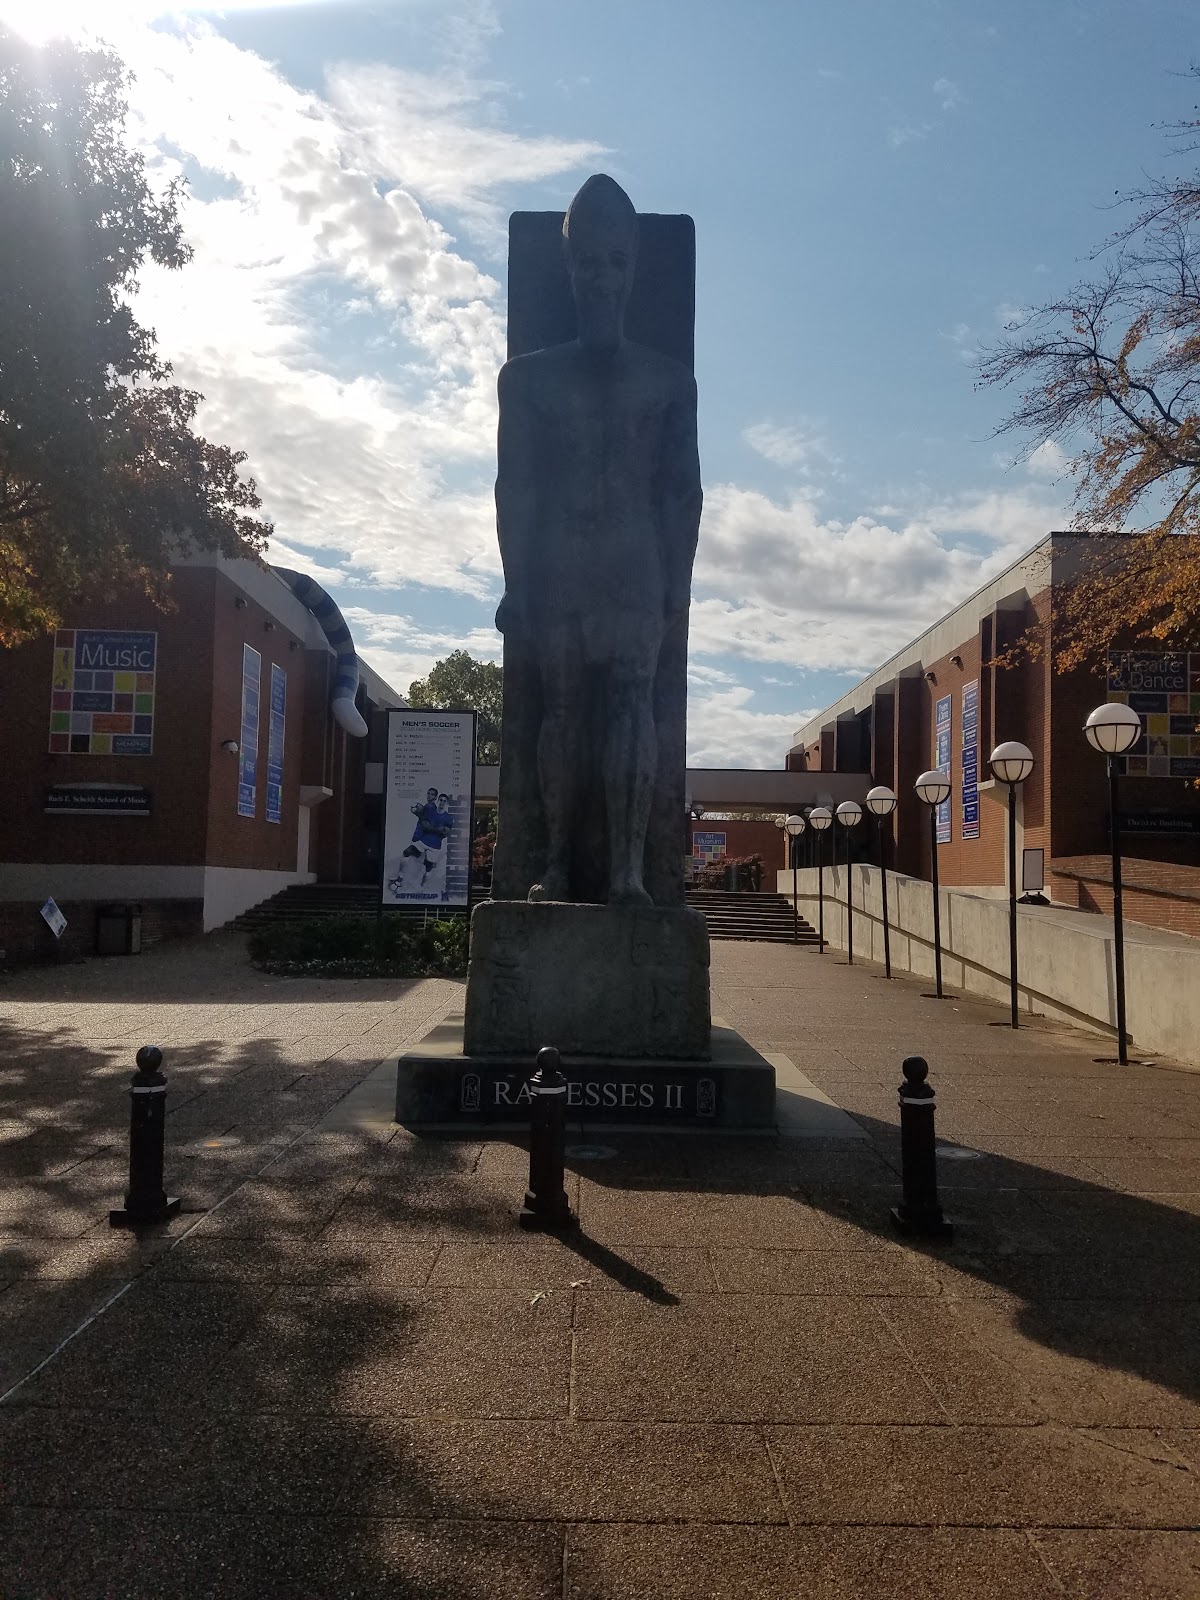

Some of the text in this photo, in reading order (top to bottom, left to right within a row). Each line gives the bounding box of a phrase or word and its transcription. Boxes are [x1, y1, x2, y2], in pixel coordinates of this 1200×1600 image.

[81, 643, 151, 667] Music
[1113, 671, 1184, 688] & Dance
[493, 1081, 685, 1109] RAESSES II
